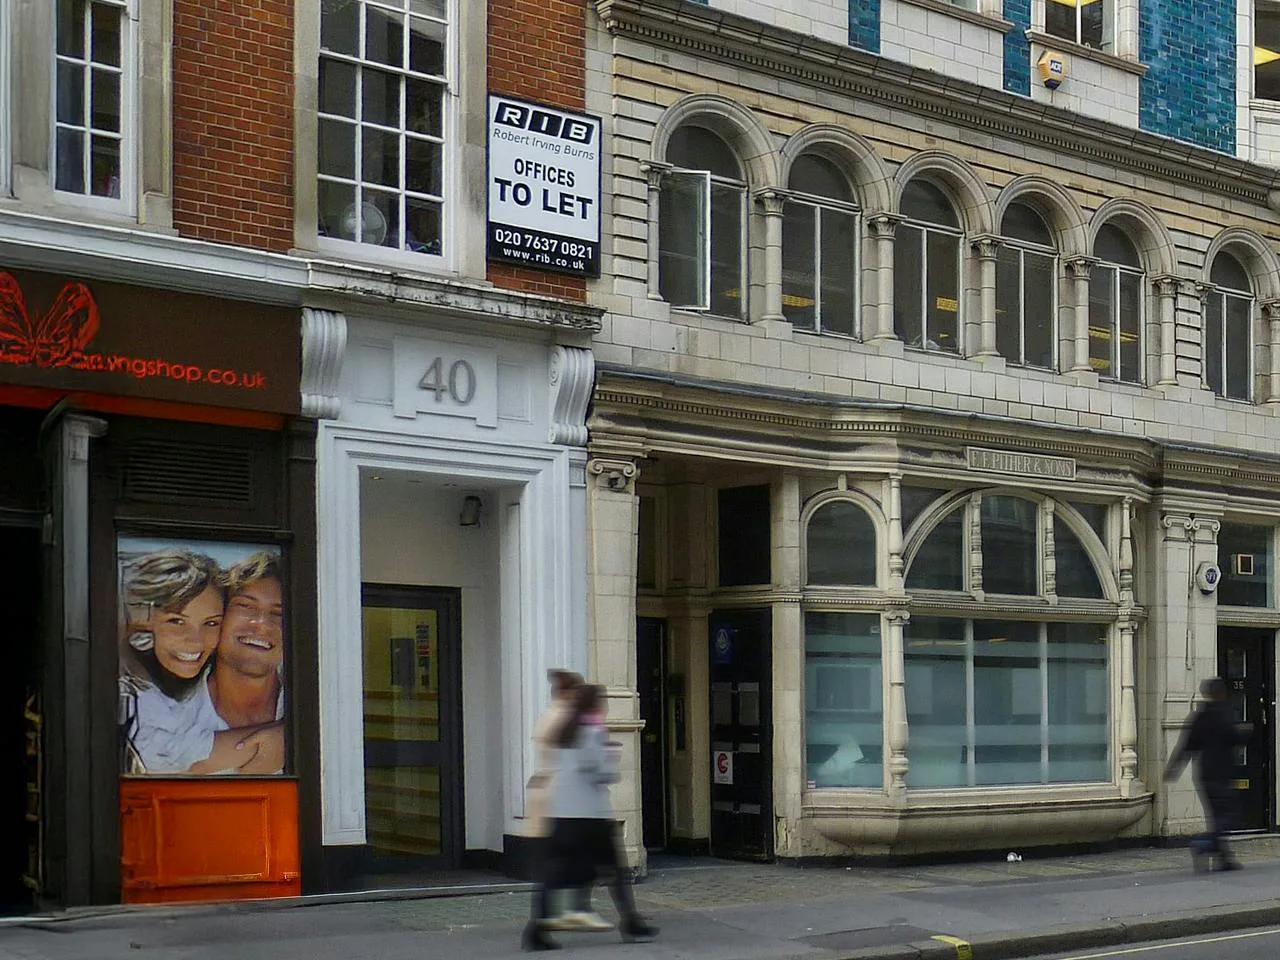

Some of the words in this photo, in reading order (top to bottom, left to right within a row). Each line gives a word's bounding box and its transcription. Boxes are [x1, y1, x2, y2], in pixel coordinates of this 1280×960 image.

[499, 104, 590, 143] RIB
[493, 128, 530, 145] Robert
[532, 137, 562, 155] Irving
[564, 145, 595, 161] Burns
[514, 158, 575, 188] OFFICES
[494, 177, 532, 207] TO
[542, 188, 593, 220] LET
[495, 228, 521, 246] 020
[524, 234, 558, 253] 7637
[561, 242, 593, 260] 0821
[503, 247, 585, 271] www.rib.co.uk
[418, 356, 477, 406] 40
[1034, 457, 1042, 475] &
[1044, 458, 1073, 477] SONS
